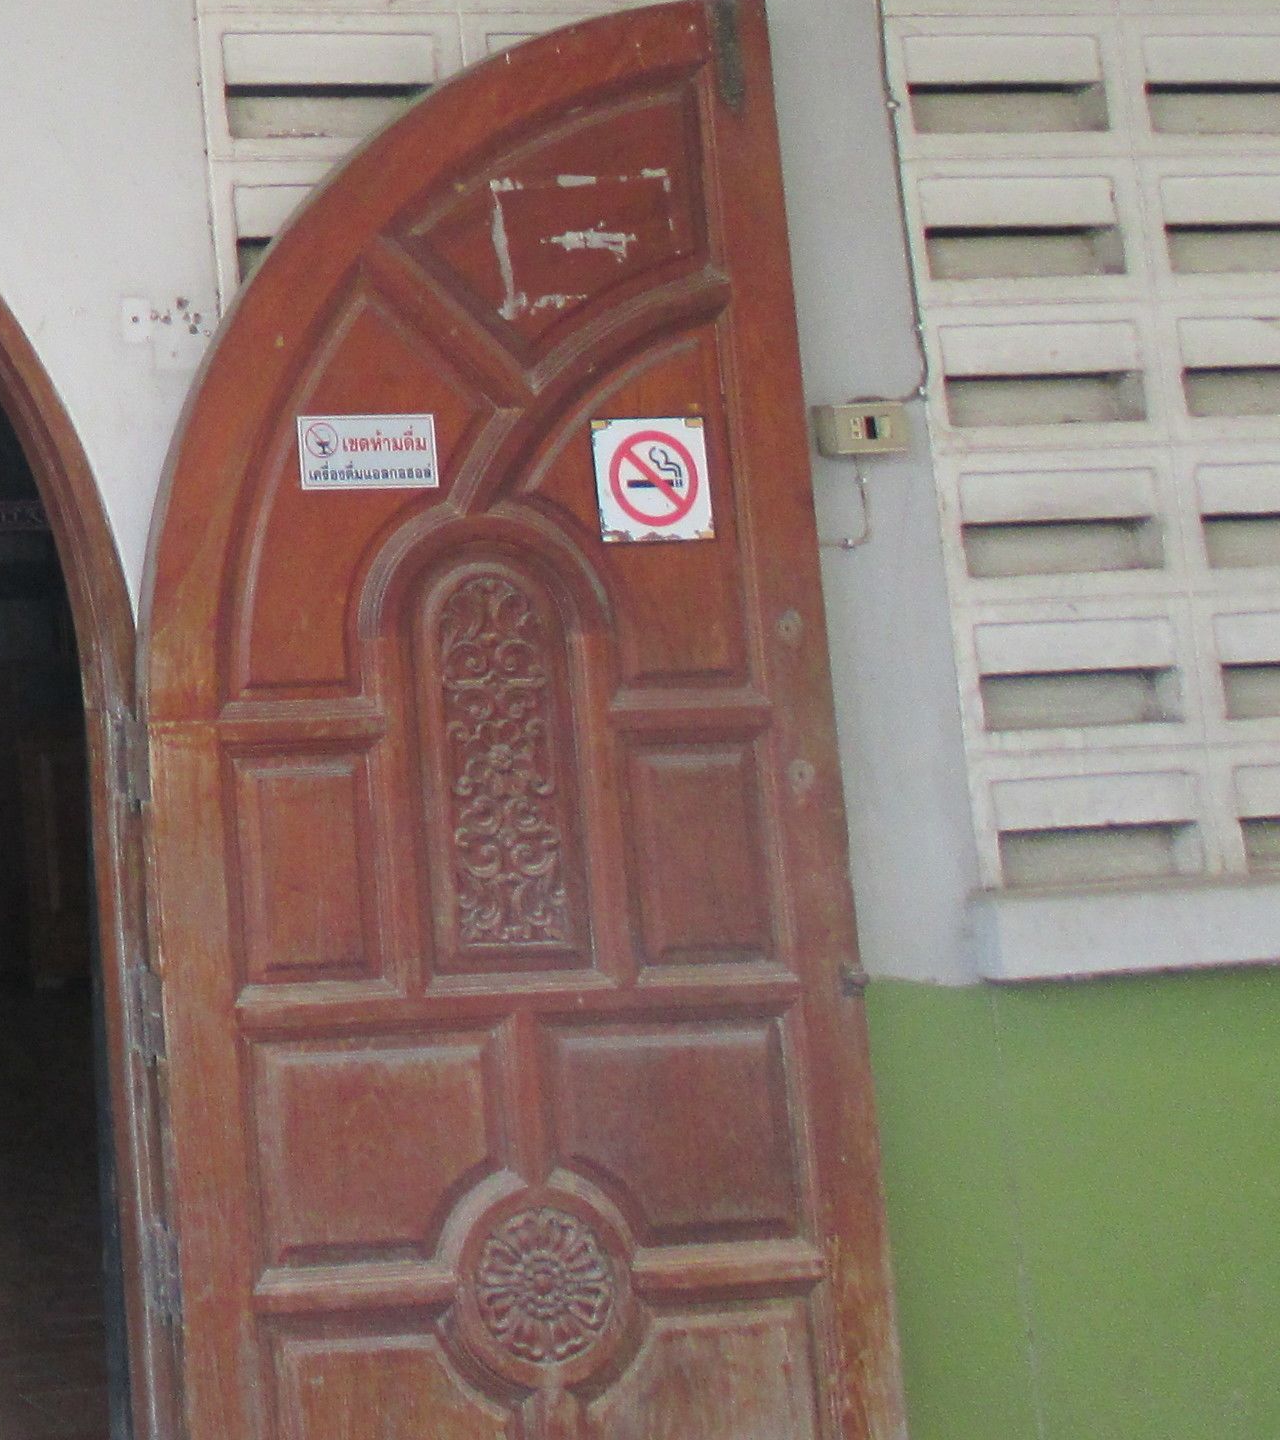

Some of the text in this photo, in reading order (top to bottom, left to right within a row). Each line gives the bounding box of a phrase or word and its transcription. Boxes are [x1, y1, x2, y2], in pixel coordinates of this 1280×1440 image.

[342, 425, 427, 453] เขตห้ามดื่ม
